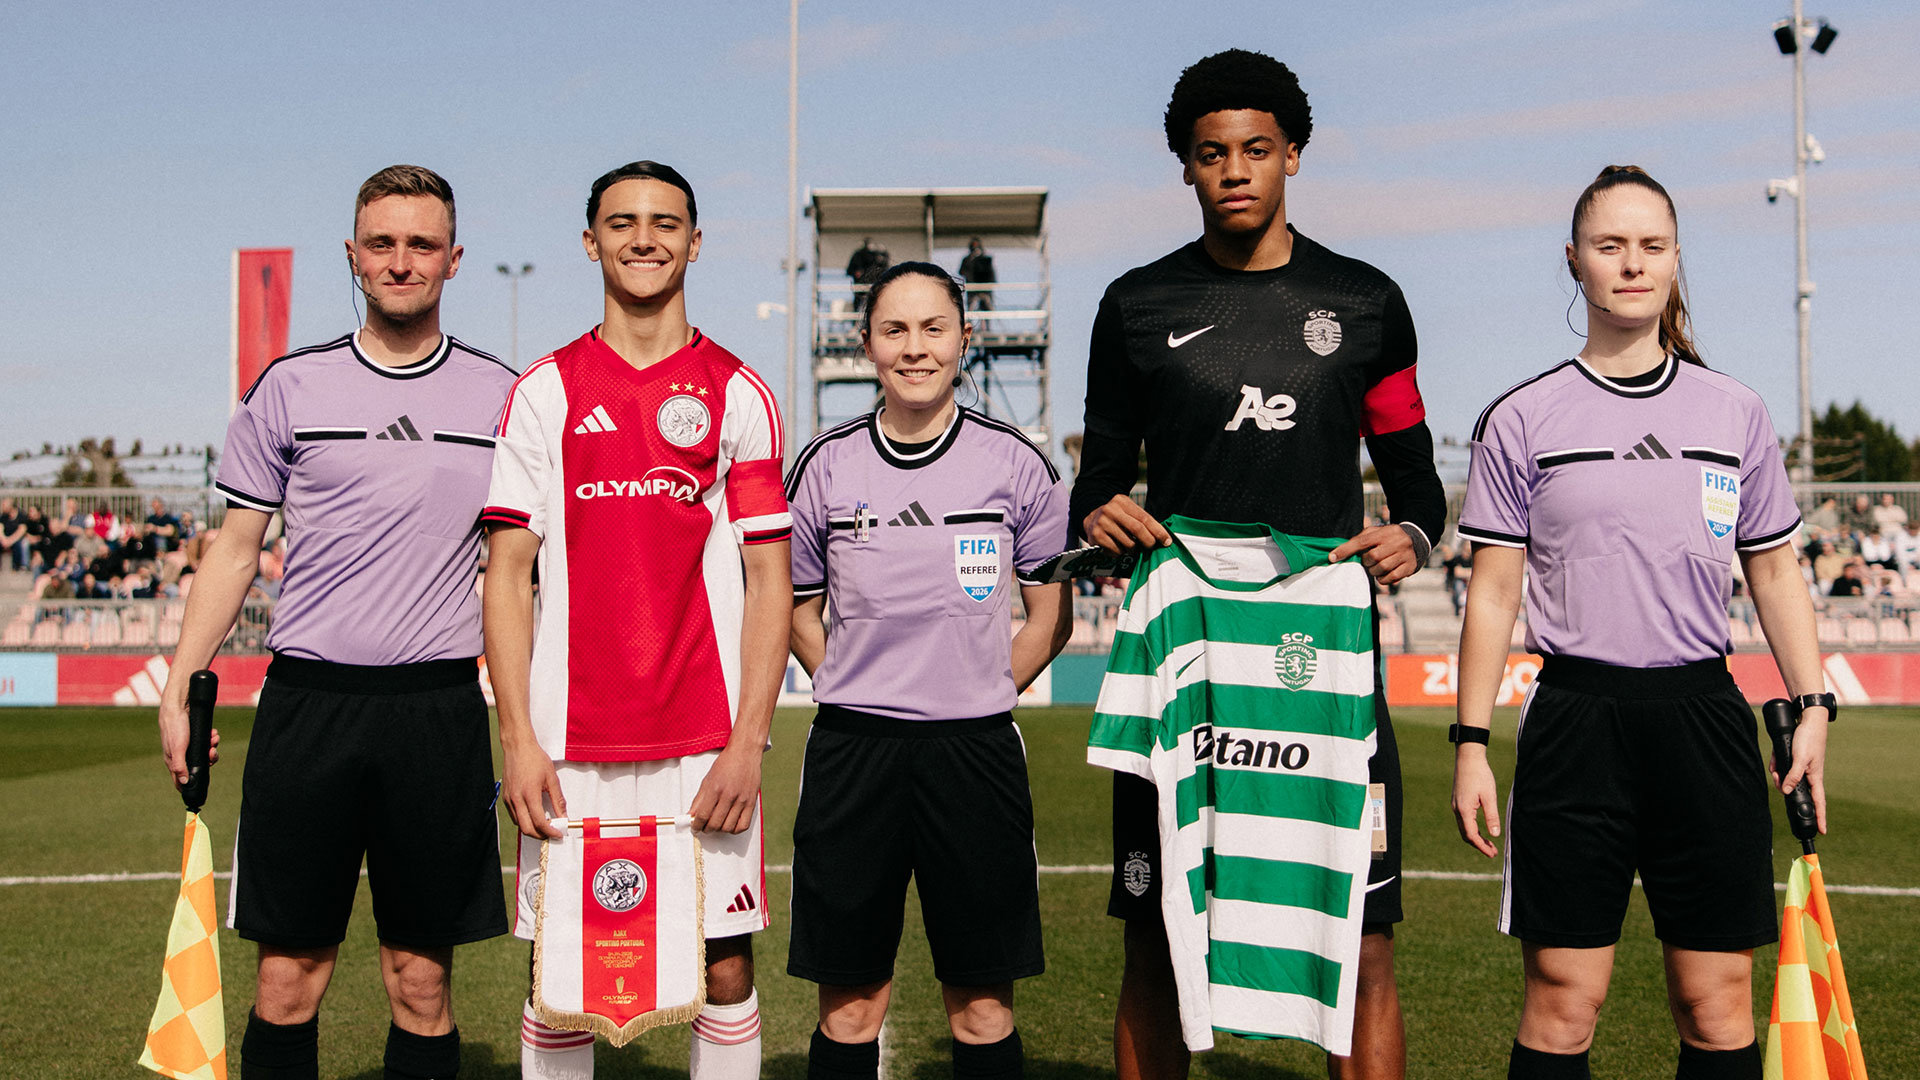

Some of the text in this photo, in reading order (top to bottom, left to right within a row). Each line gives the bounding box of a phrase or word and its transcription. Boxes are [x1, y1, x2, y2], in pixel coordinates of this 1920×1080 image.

[1308, 309, 1337, 320] SCP
[1307, 320, 1339, 331] SPORTING
[1705, 471, 1737, 495] FIFA
[575, 476, 699, 503] OLYMPIA
[1712, 522, 1728, 534] 2026
[960, 539, 997, 555] FIFA
[960, 565, 997, 575] REFEREE
[971, 587, 989, 597] 2026
[1281, 632, 1314, 643] SCP
[1278, 645, 1315, 660] SPORTING
[1422, 653, 1541, 706] zio
[1193, 725, 1310, 771] Btano
[1128, 851, 1148, 860] SCP
[597, 862, 629, 897] AJAX
[595, 939, 645, 947] SPORTING PORTUGAL
